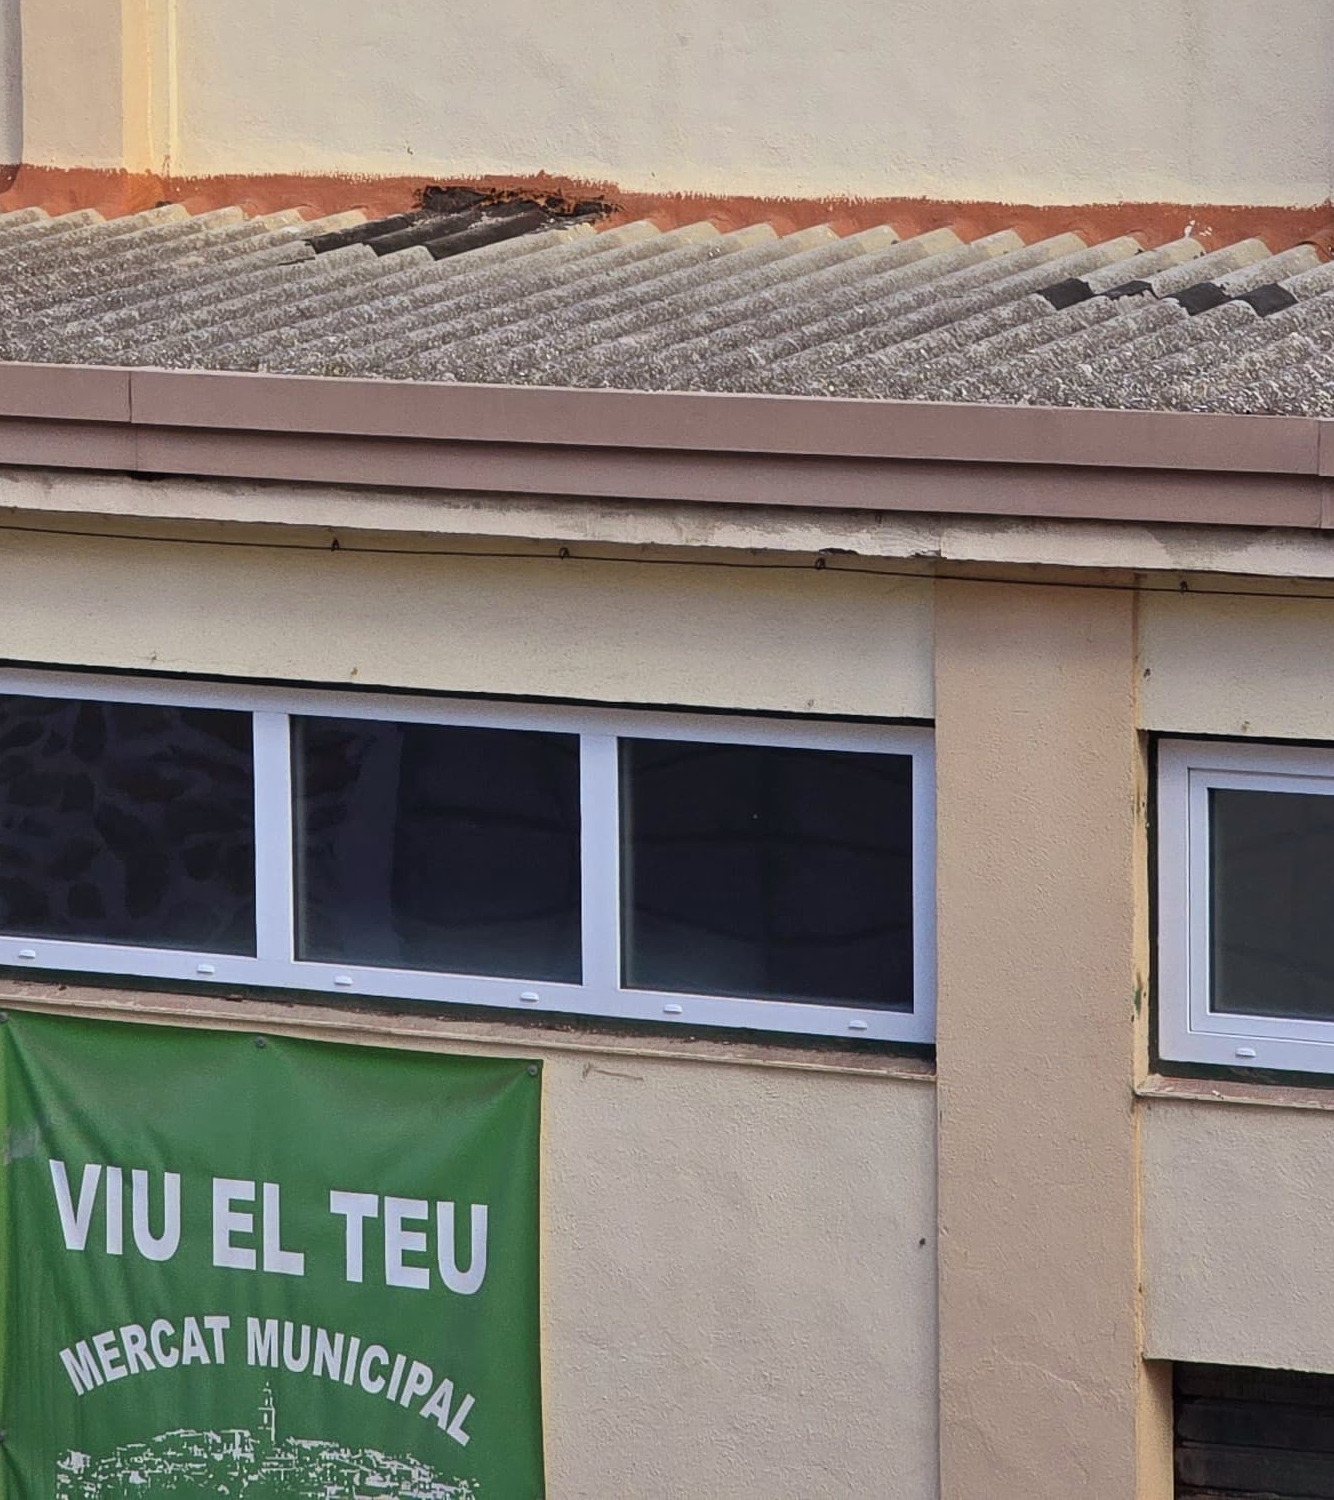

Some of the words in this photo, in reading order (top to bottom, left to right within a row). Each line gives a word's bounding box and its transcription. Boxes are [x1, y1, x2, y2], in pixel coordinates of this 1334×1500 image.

[48, 1158, 182, 1262] VIU
[212, 1177, 305, 1276] EL
[329, 1190, 488, 1295] TEU
[58, 1315, 230, 1396] MERCAT
[246, 1316, 476, 1446] MUNICIPAL
